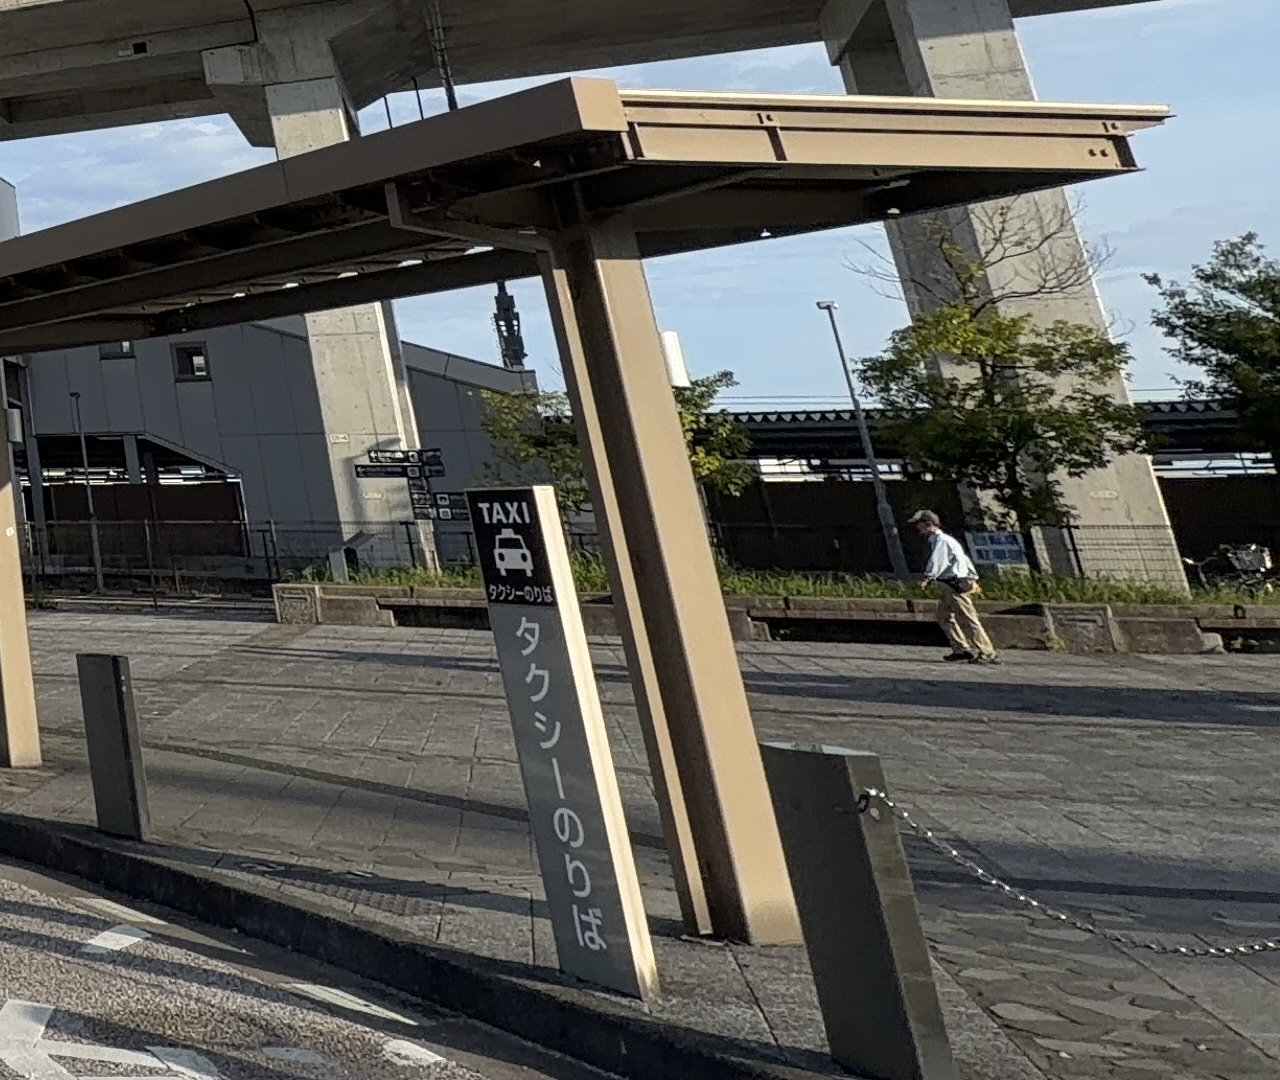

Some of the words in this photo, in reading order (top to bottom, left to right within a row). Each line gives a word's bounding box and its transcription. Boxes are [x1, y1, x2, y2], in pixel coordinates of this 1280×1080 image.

[478, 501, 531, 524] TAXI
[488, 584, 553, 603] タクシーのりば
[516, 617, 607, 951] タクシーのりば
